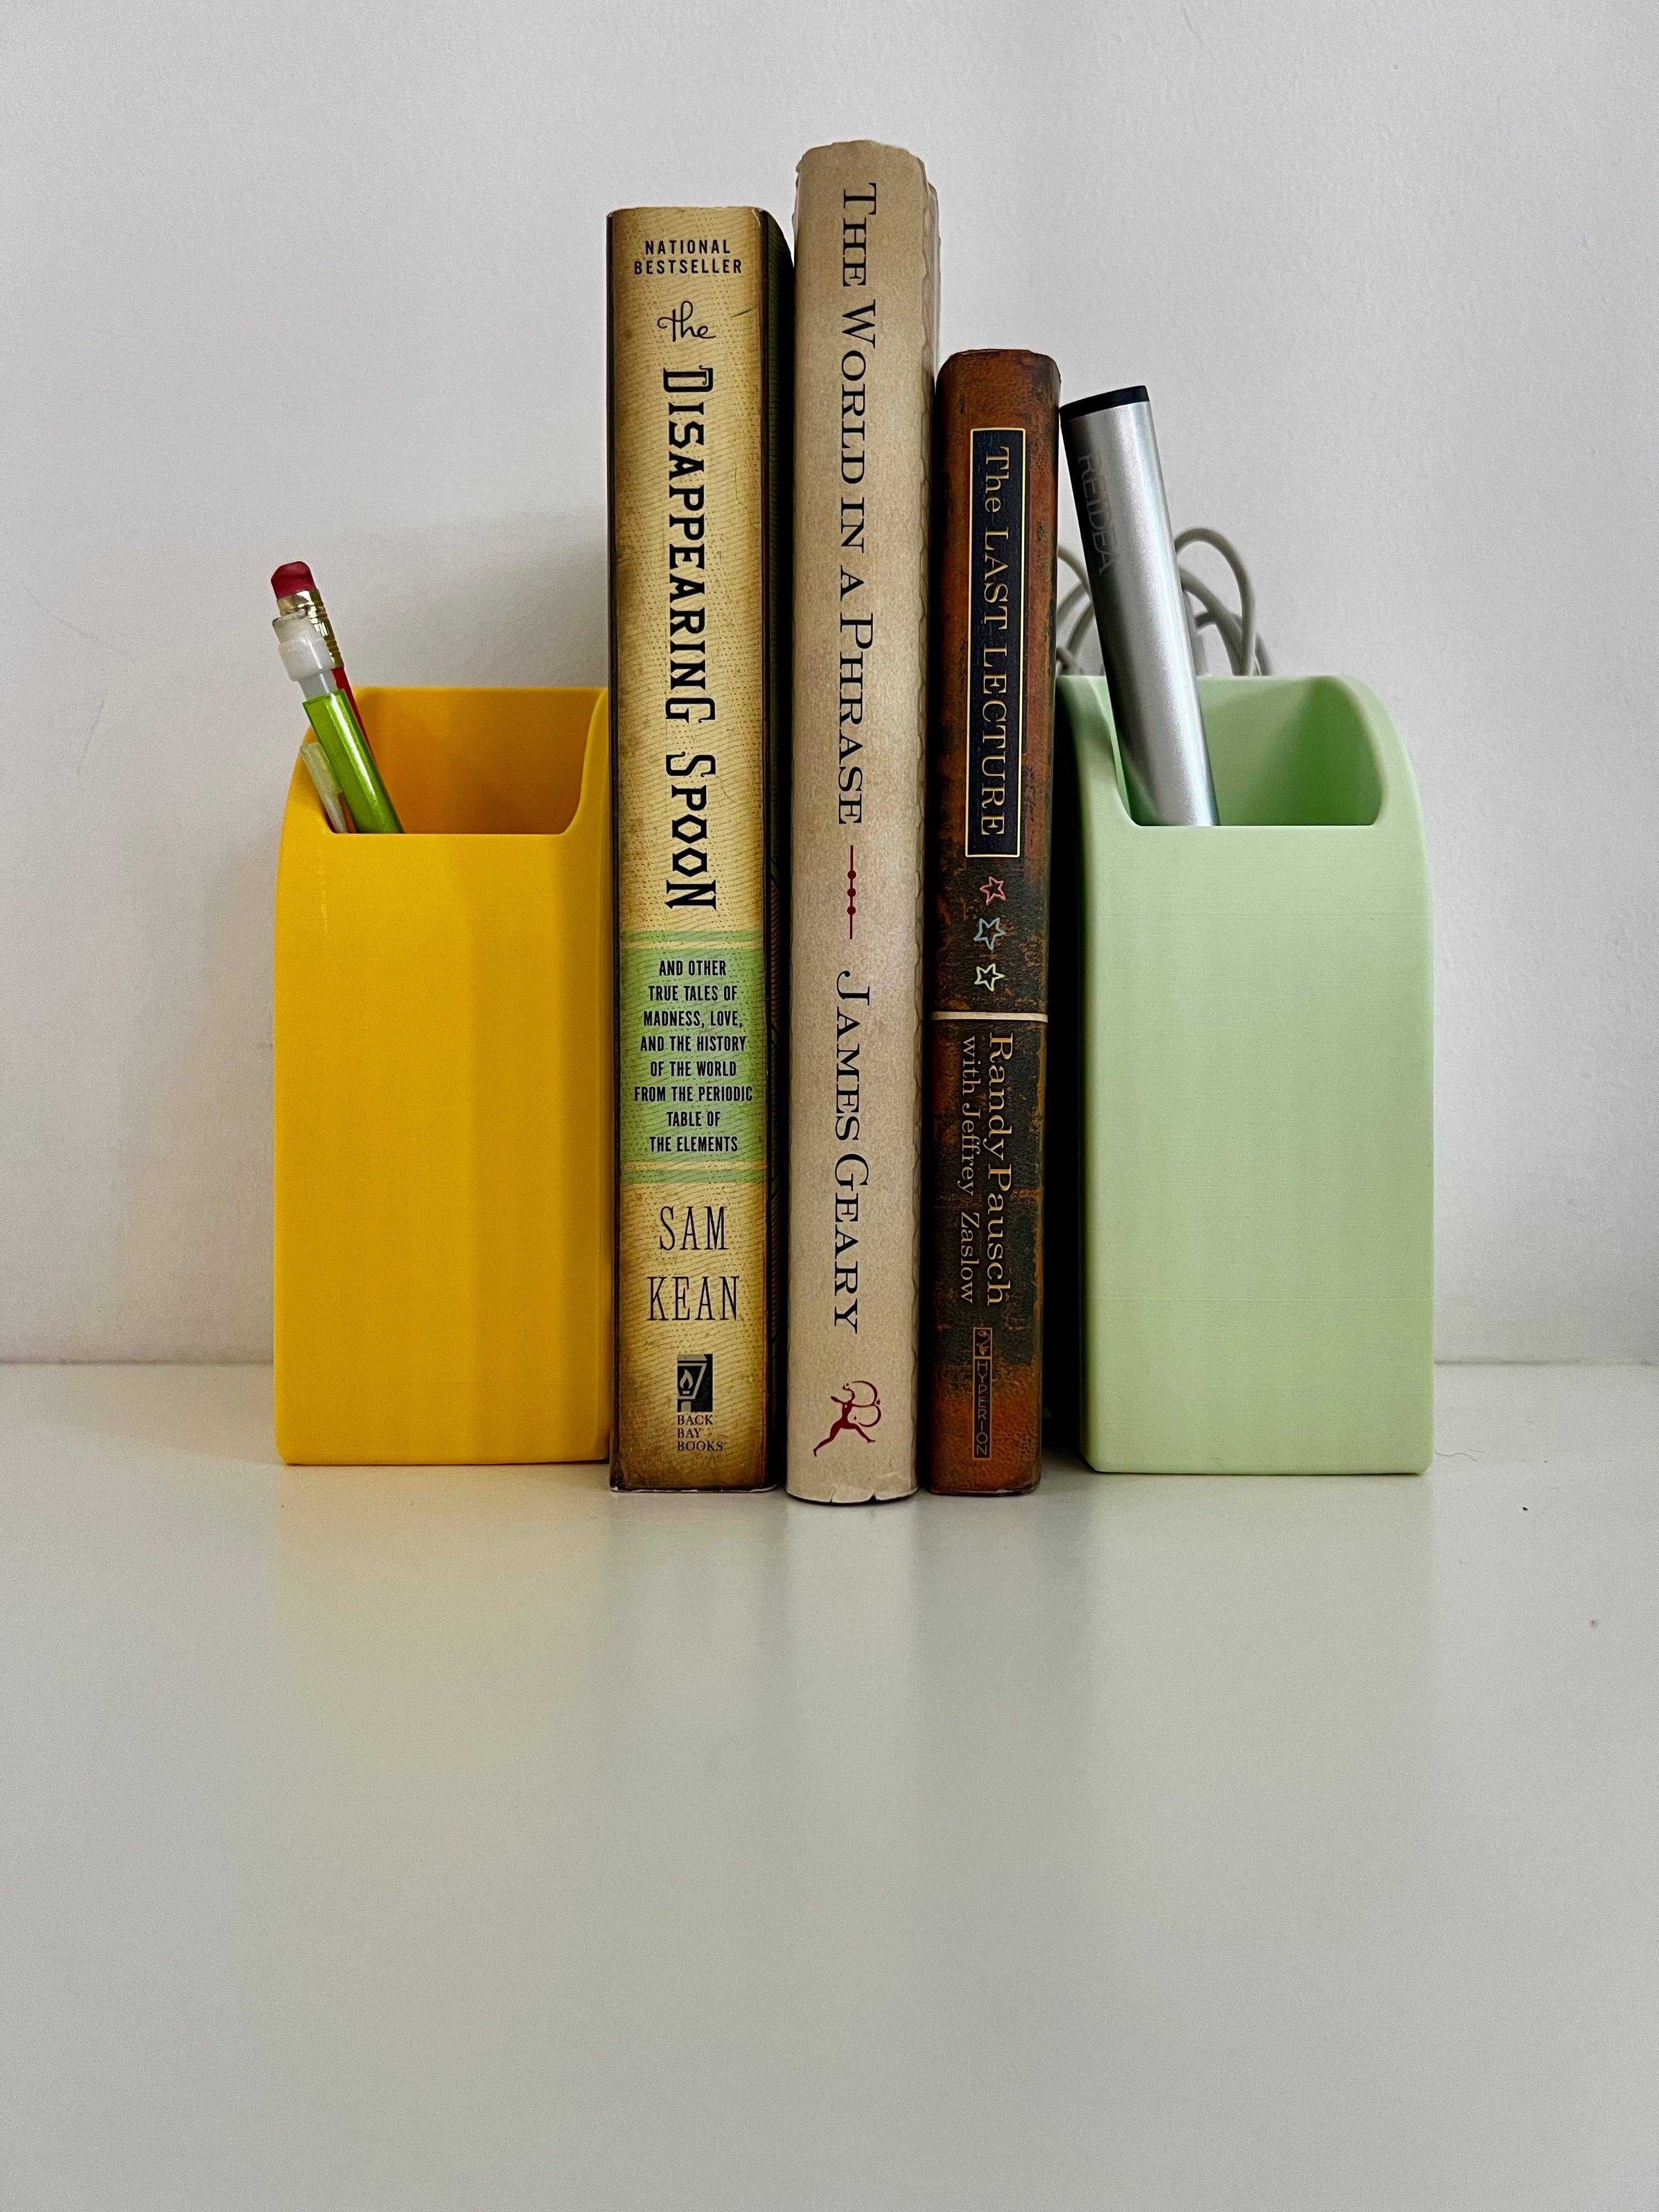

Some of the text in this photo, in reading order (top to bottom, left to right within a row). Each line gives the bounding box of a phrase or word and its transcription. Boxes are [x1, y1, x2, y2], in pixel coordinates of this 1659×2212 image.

[645, 240, 731, 255] NATIONAL
[634, 258, 742, 274] BESTSELLER
[658, 301, 716, 342] the
[838, 183, 877, 825] THE WORLD IN A PHRASE
[663, 365, 716, 910] DISAPPEARING SPOON
[981, 446, 1009, 836] The LAST LECTURE
[659, 961, 726, 977] AND OTHER
[648, 985, 737, 1001] TRUE TALES OF
[644, 1011, 743, 1029] MADNESS, LOVE,
[640, 1036, 746, 1052] AND THE HISTORY
[650, 1061, 736, 1076] OF THE WORLD
[634, 1086, 753, 1102] FROM THE PERIODIC
[667, 1111, 721, 1127] TABLE OF
[650, 1136, 738, 1152] THE ELEMENTS
[834, 970, 870, 1334] JAMES GEARY
[957, 1035, 981, 1304] with Jeffrey Zaslow
[983, 1032, 1013, 1307] Randy Pausch
[659, 1206, 729, 1251] SAM
[646, 1276, 740, 1321] KEAN
[977, 1361, 988, 1455] HYPERION
[677, 1415, 713, 1425] BACK
[677, 1427, 701, 1438] BAY
[677, 1441, 724, 1452] BOOKS
